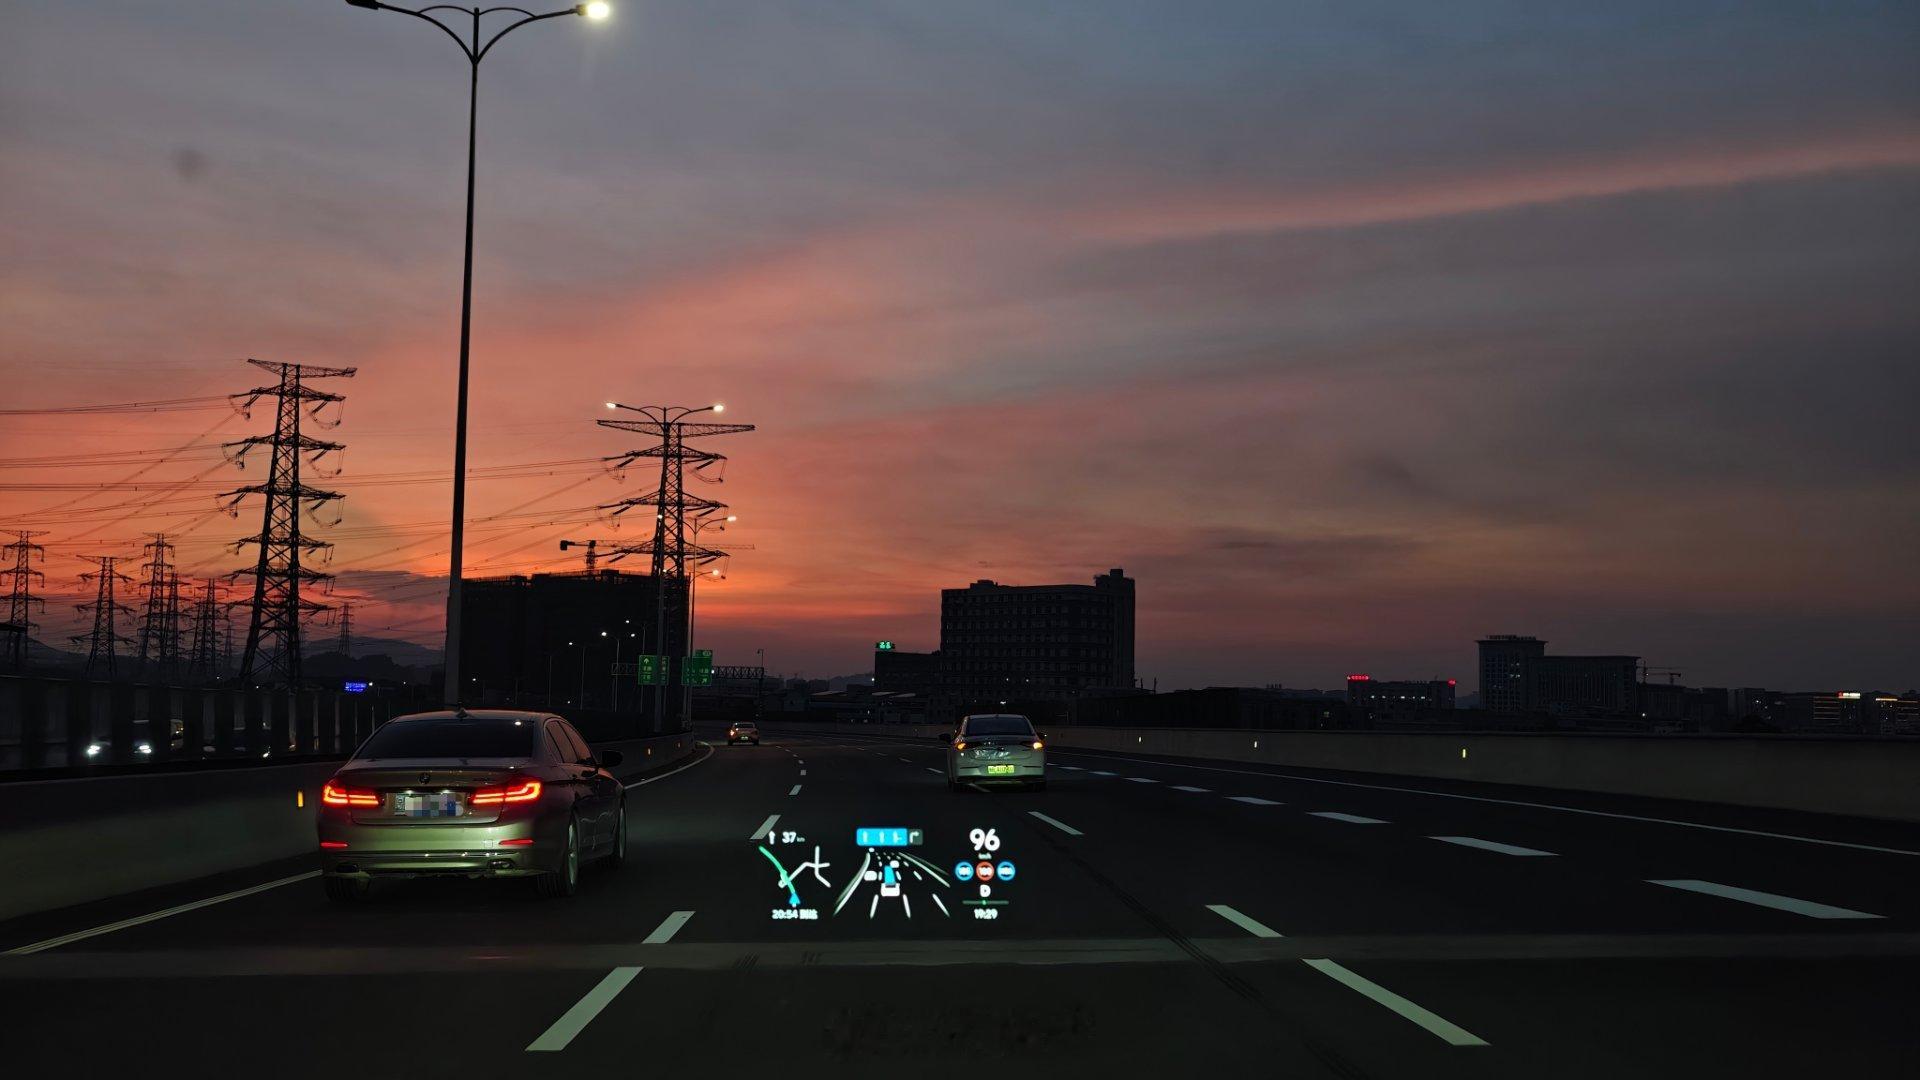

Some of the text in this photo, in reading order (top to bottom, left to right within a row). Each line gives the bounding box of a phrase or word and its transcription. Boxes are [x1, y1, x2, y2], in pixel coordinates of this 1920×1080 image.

[782, 831, 797, 844] 37
[970, 829, 1000, 851] 96
[979, 884, 991, 898] D
[772, 909, 798, 920] 20:54
[974, 908, 999, 920] 19:29
